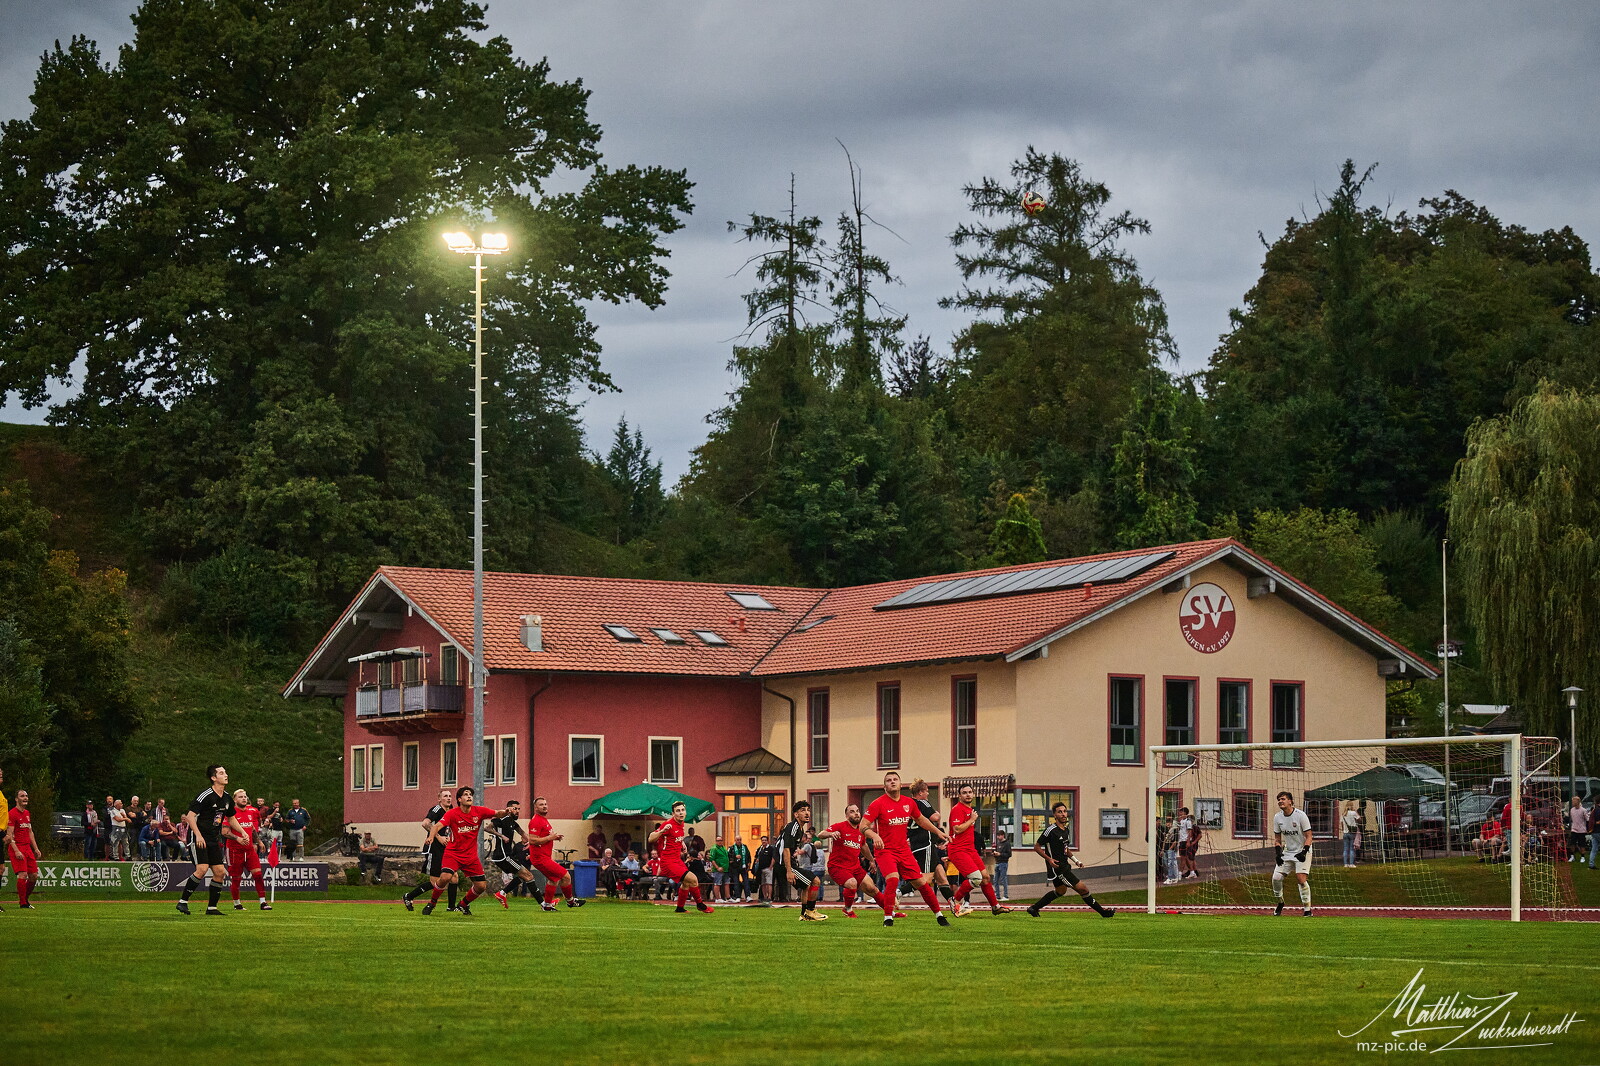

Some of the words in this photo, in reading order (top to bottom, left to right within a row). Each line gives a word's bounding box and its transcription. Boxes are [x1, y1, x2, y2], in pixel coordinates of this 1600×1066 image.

[1190, 595, 1226, 631] SV
[1182, 624, 1205, 652] LAUFEN
[1217, 630, 1231, 648] 1927
[61, 866, 122, 879] AICHER
[262, 867, 319, 880] AICHER
[60, 879, 68, 887] &
[69, 879, 122, 887] RECYCLING
